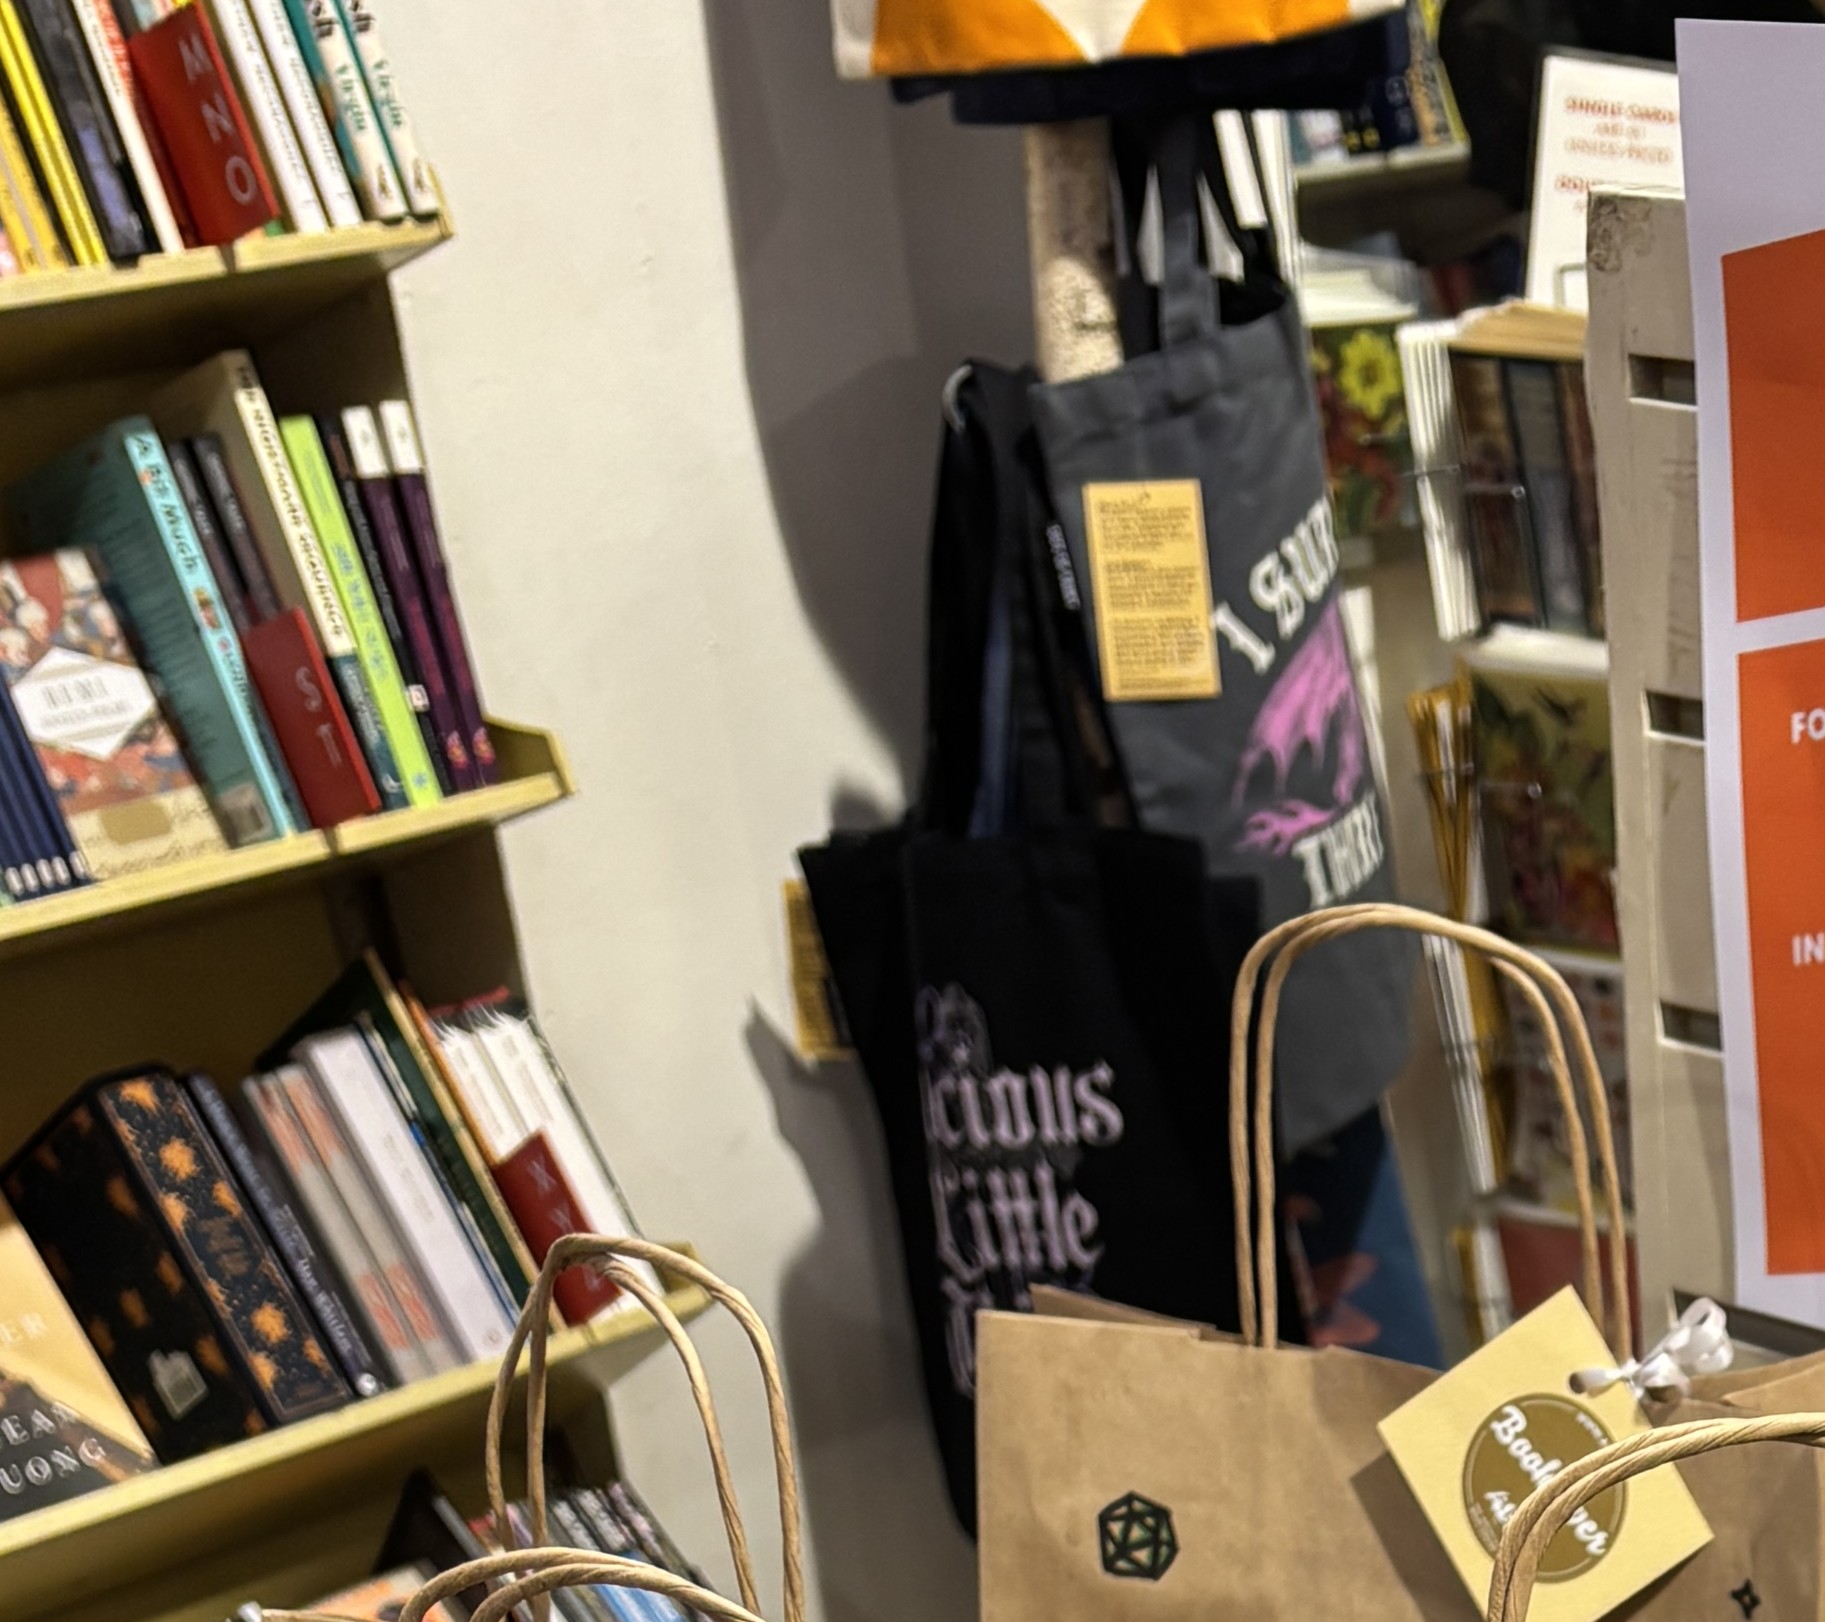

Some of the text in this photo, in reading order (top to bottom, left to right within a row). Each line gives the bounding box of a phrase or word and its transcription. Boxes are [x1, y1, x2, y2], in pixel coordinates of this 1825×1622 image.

[178, 33, 257, 205] M N O
[1792, 934, 1825, 966] IN
